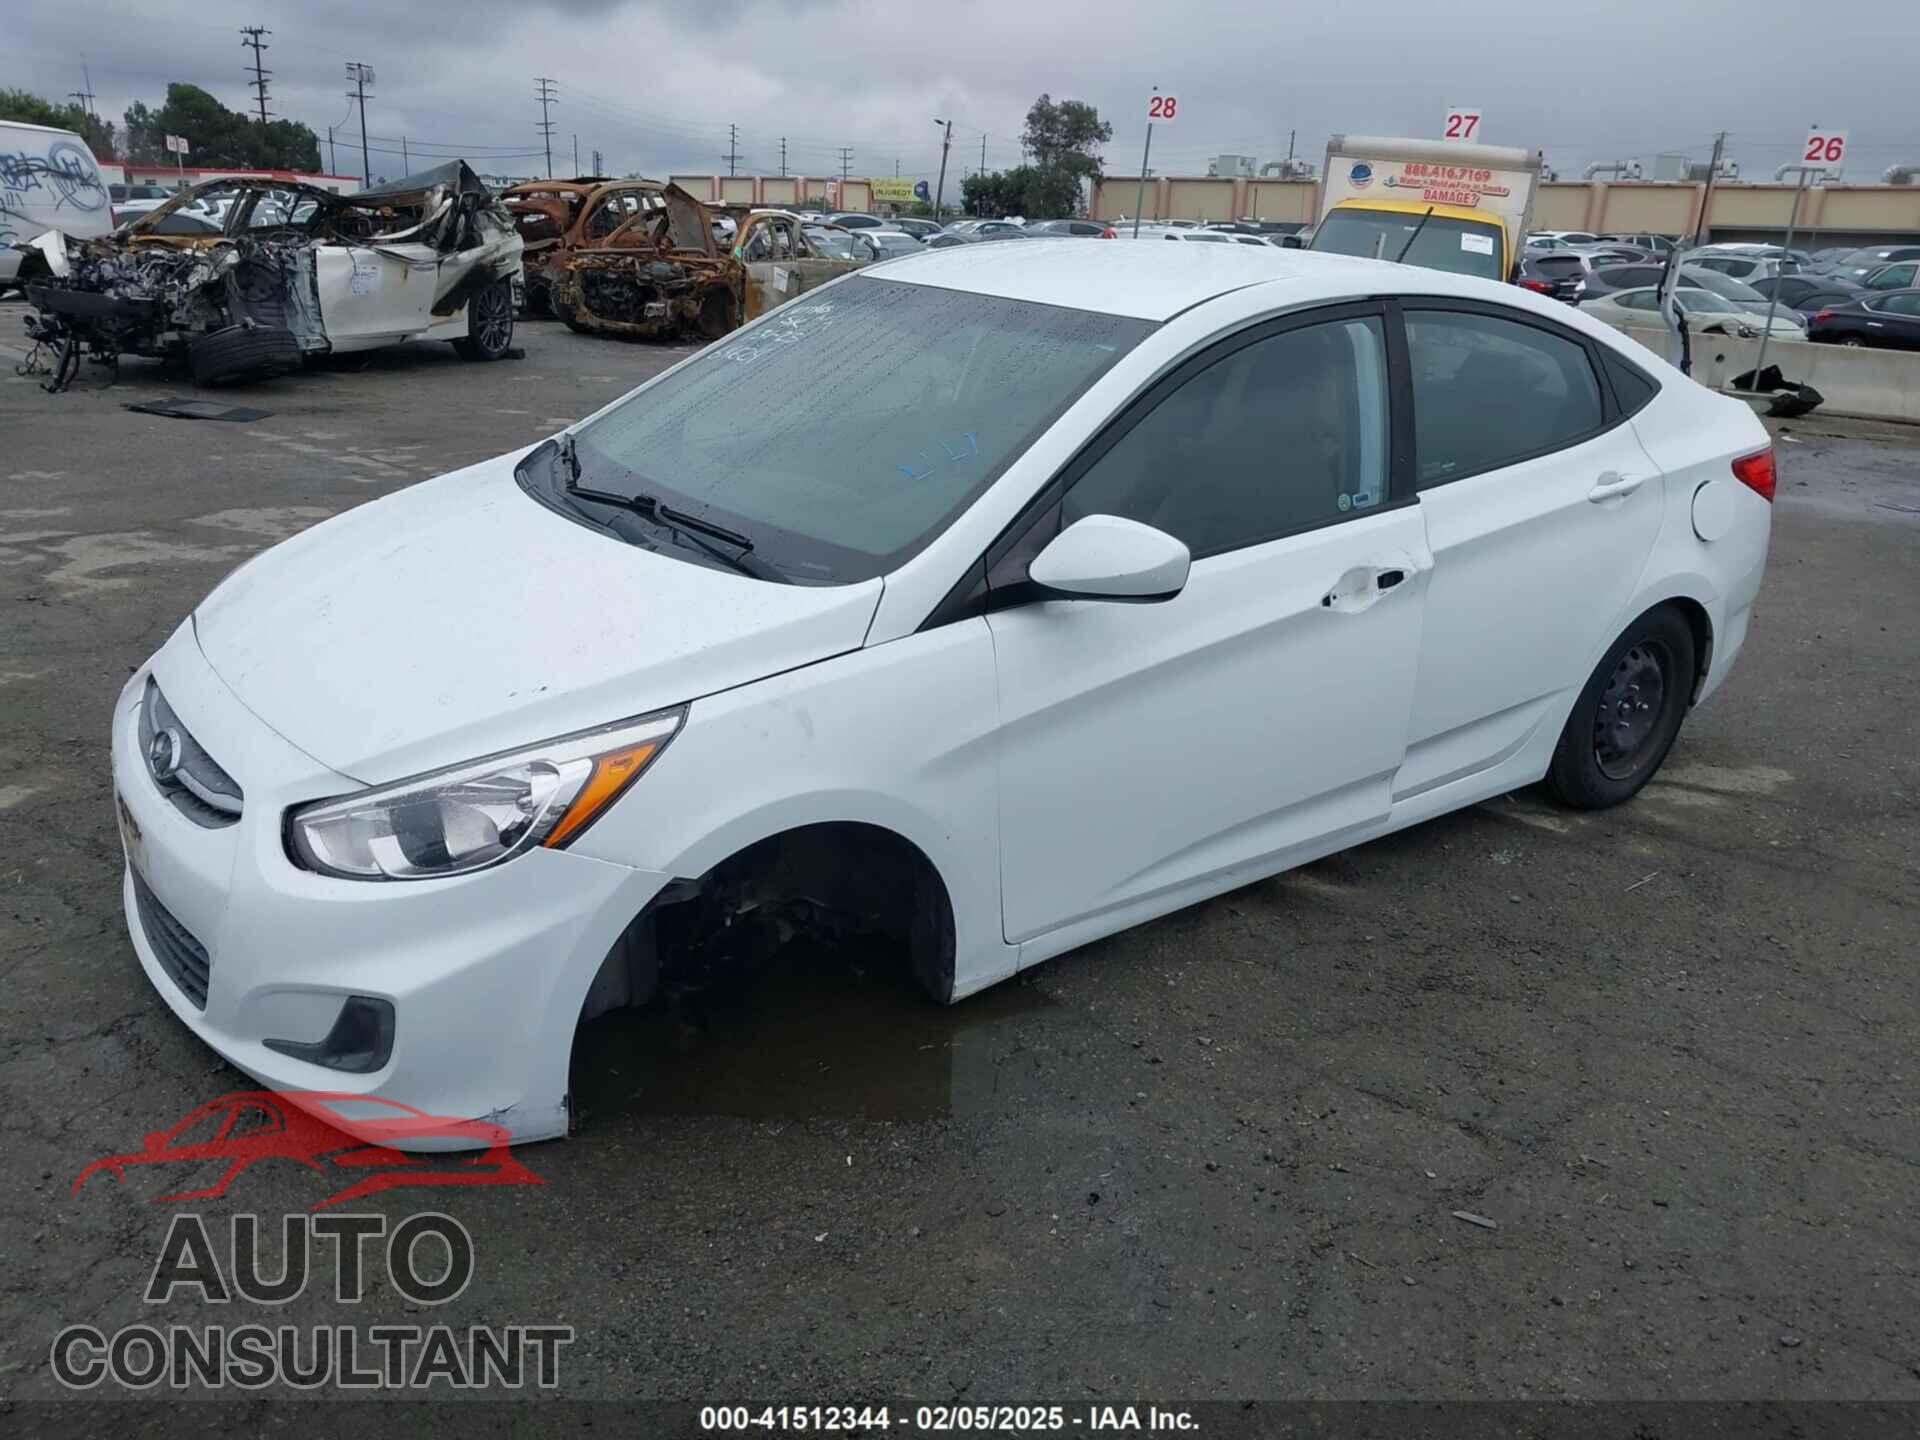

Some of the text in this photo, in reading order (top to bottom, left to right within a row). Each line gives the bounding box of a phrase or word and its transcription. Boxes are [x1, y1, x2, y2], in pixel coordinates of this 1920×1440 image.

[1149, 96, 1177, 119] 28
[1446, 114, 1480, 138] 27
[1804, 136, 1844, 162] 26
